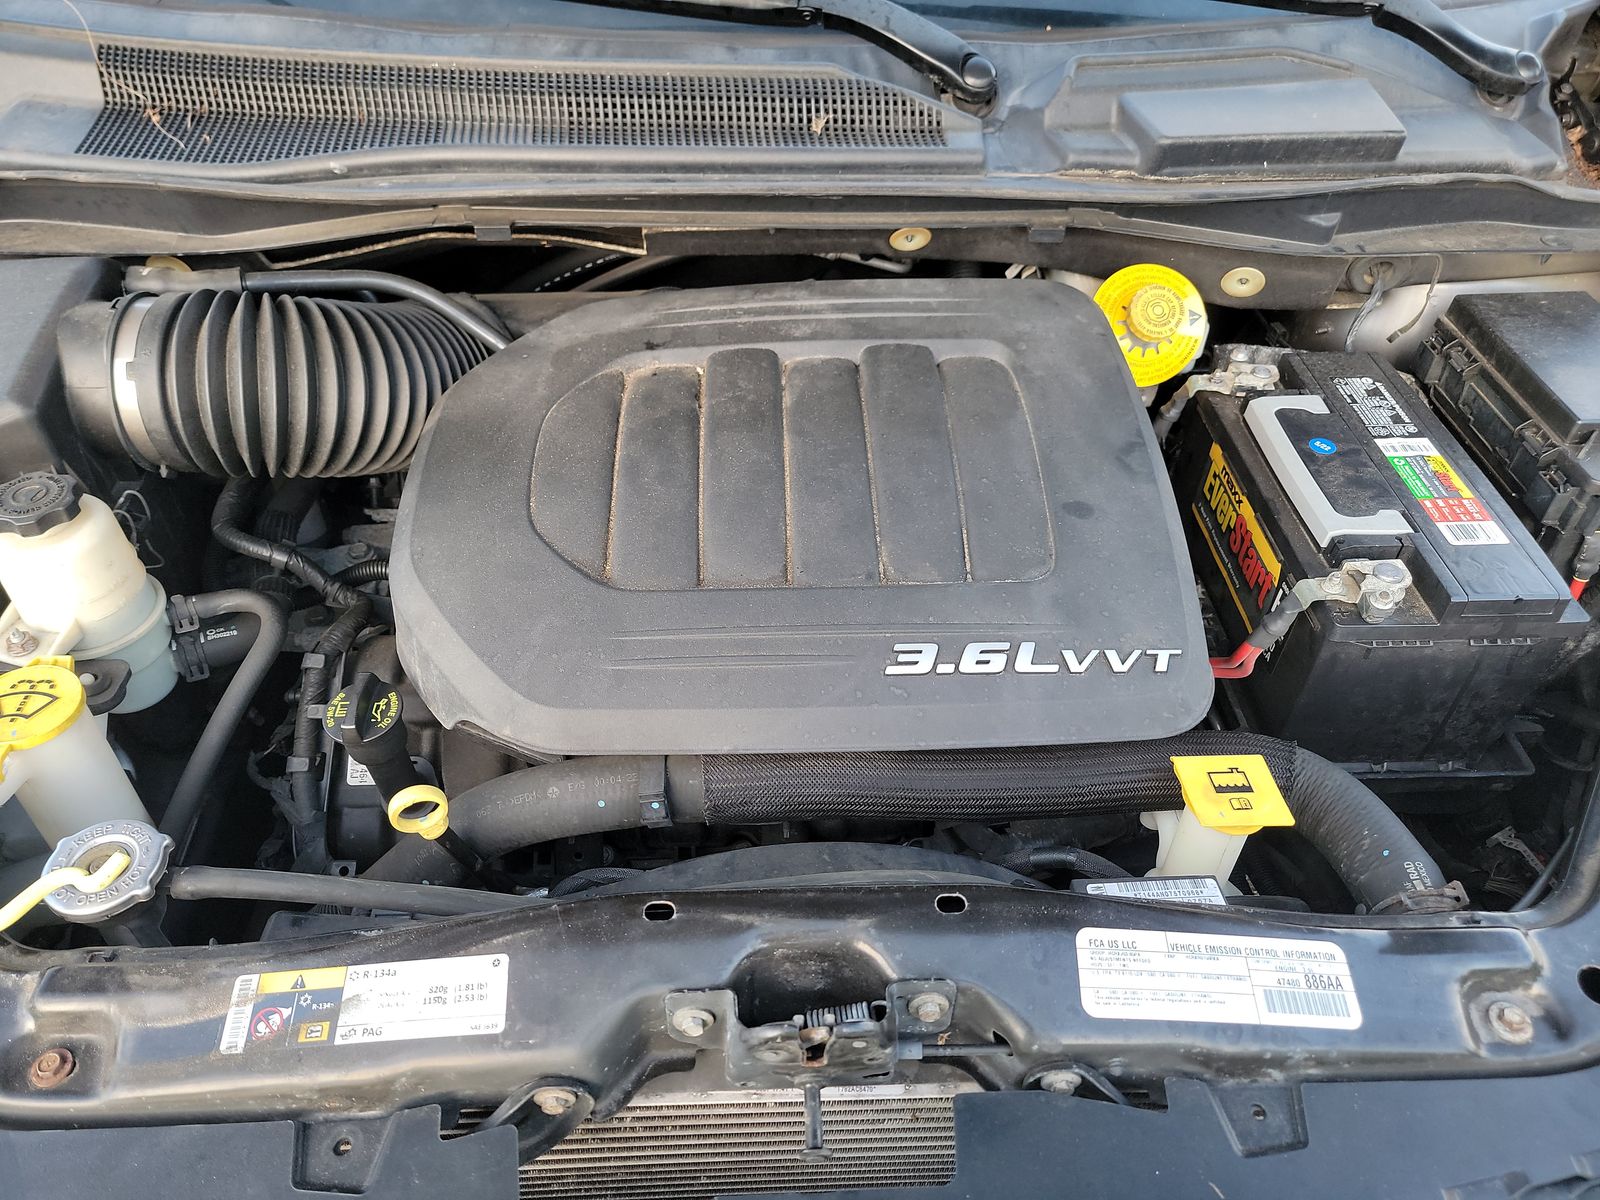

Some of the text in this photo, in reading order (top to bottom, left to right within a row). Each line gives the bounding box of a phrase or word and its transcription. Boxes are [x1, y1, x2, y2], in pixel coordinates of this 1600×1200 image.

[1203, 462, 1274, 610] EverStart
[884, 641, 1183, 675] 3.6L VVT
[326, 692, 346, 728] SAE 5W-20
[377, 691, 399, 729] ENGINE OIL
[72, 823, 114, 848] KEEP
[1403, 861, 1416, 881] RAD
[50, 864, 147, 906] OT OPEN HOT
[1089, 939, 1137, 949] FCA US LLC
[1170, 943, 1336, 961] VEHICLE EMISSION CONTROL INFORMATION
[363, 969, 397, 979] R-134a
[1277, 974, 1344, 991] 47480 886AA
[422, 996, 448, 1006] 1150g
[362, 1027, 383, 1037] PAG
